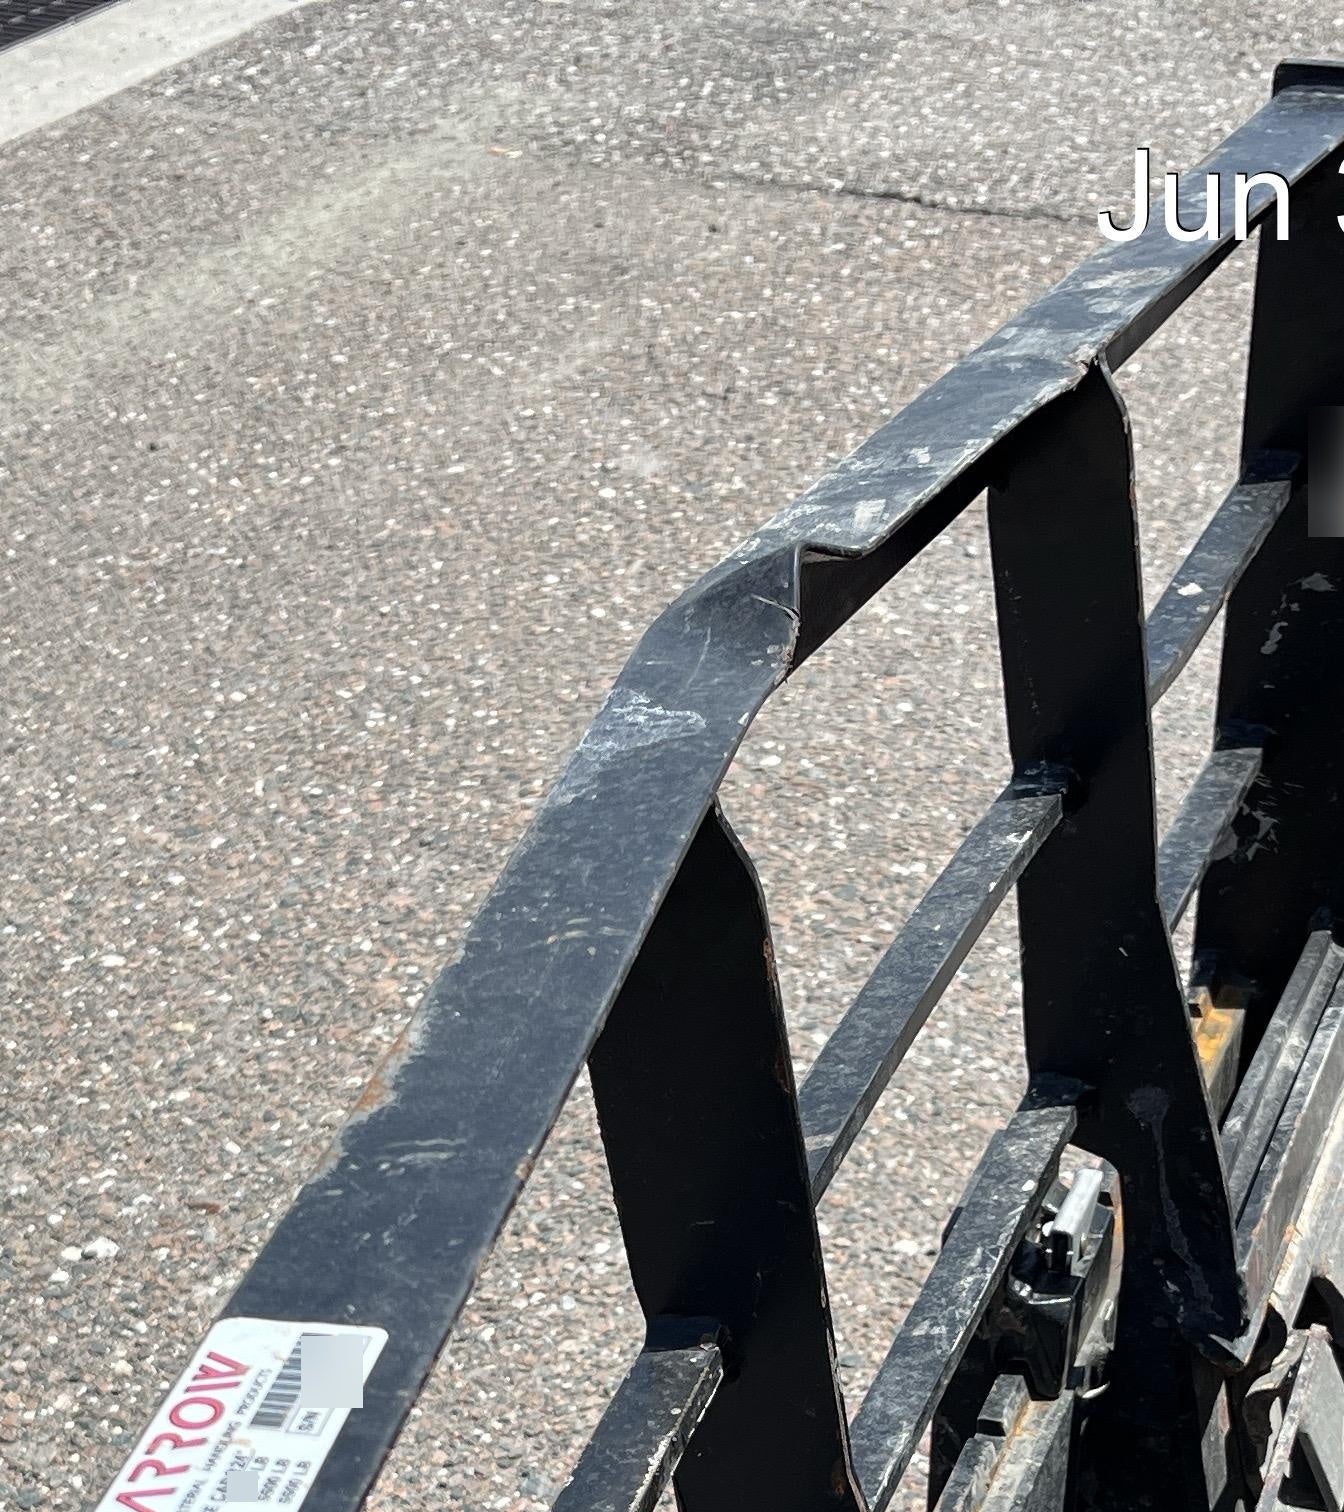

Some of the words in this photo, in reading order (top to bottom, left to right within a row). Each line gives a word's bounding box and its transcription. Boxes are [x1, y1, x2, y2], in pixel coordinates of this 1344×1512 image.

[206, 1421, 241, 1471] HANDLING
[236, 1368, 272, 1415] PRODUCTS
[270, 1458, 291, 1473] LB
[291, 1460, 312, 1475] LB
